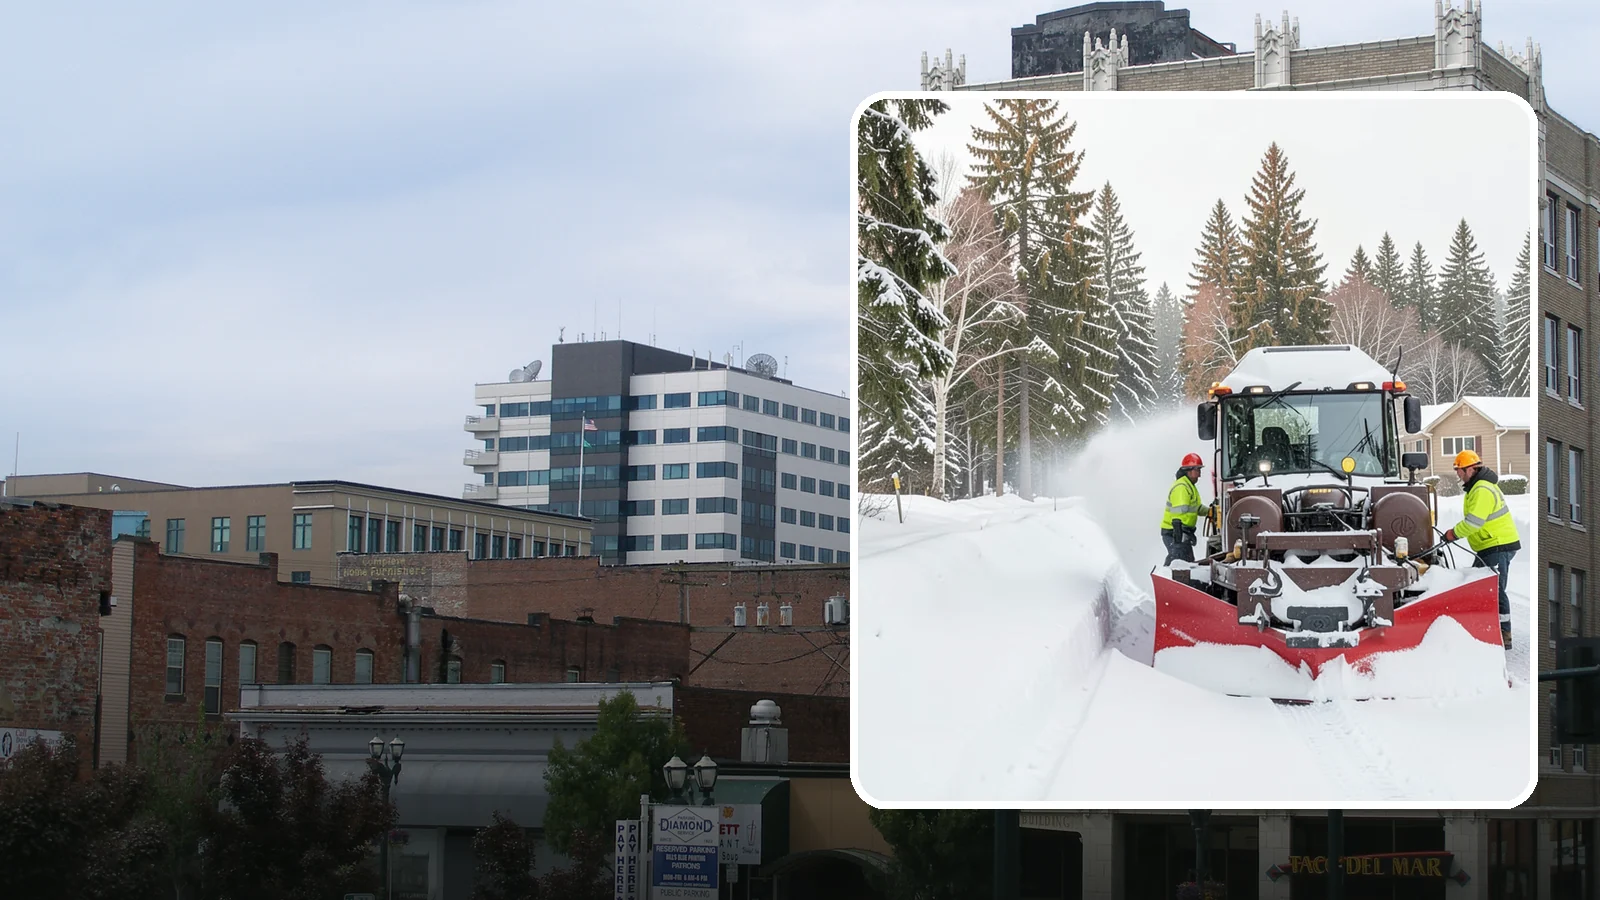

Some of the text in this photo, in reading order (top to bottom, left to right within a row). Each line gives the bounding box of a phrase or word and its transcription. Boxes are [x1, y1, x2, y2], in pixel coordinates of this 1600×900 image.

[370, 566, 427, 577] Furnishers
[660, 818, 713, 833] DIAMOND
[1021, 815, 1070, 828] BUILDING
[656, 845, 716, 854] RESERVED PARKING
[616, 824, 625, 893] PAY HERE
[627, 824, 637, 893] PAY HERE
[721, 851, 739, 863] Soup
[671, 862, 701, 870] PATRONS
[1289, 855, 1443, 877] TAC DEL MAR
[660, 889, 710, 898] PUBLIC PARKING
